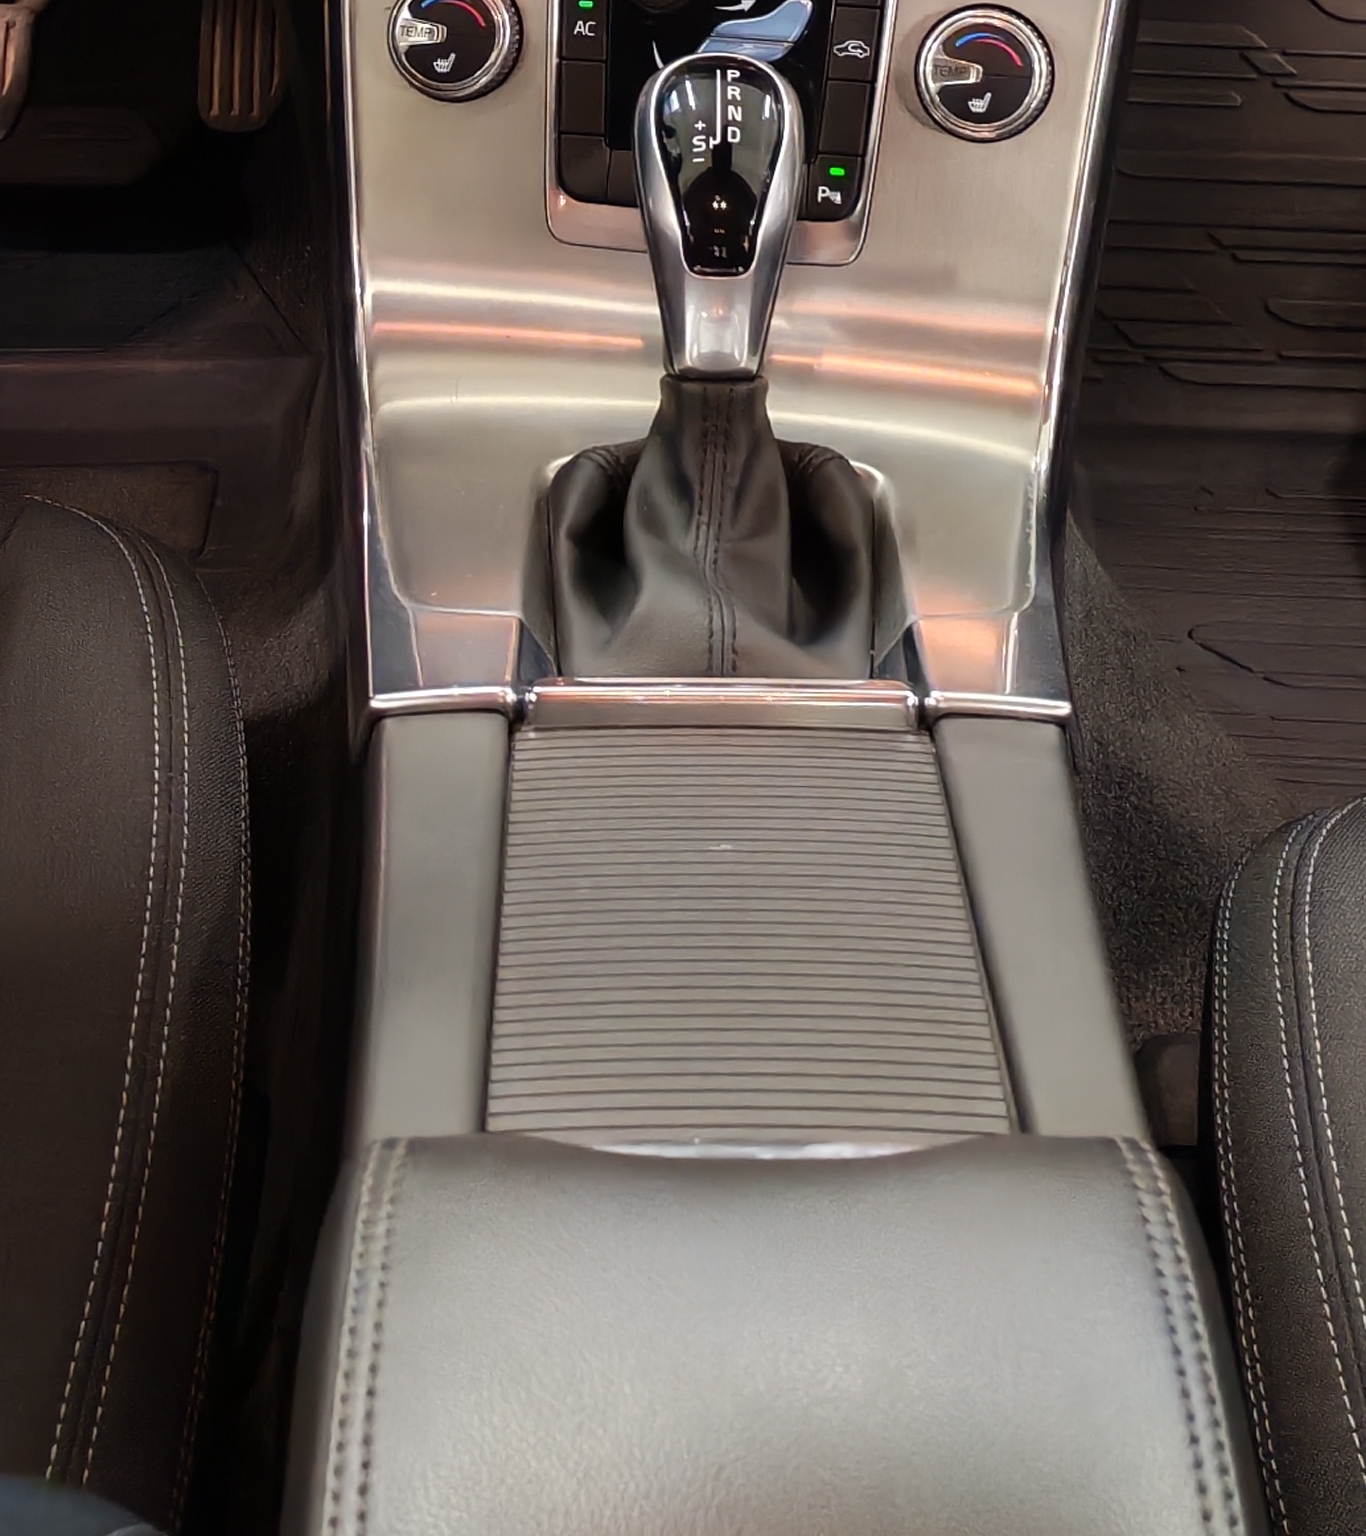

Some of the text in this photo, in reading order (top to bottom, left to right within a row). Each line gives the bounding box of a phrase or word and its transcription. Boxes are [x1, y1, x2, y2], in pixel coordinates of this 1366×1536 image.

[400, 25, 431, 38] TEMP
[573, 20, 597, 36] AC
[727, 70, 740, 82] P
[727, 87, 741, 101] R
[727, 106, 742, 121] N
[727, 127, 741, 142] D
[692, 136, 706, 152] S
